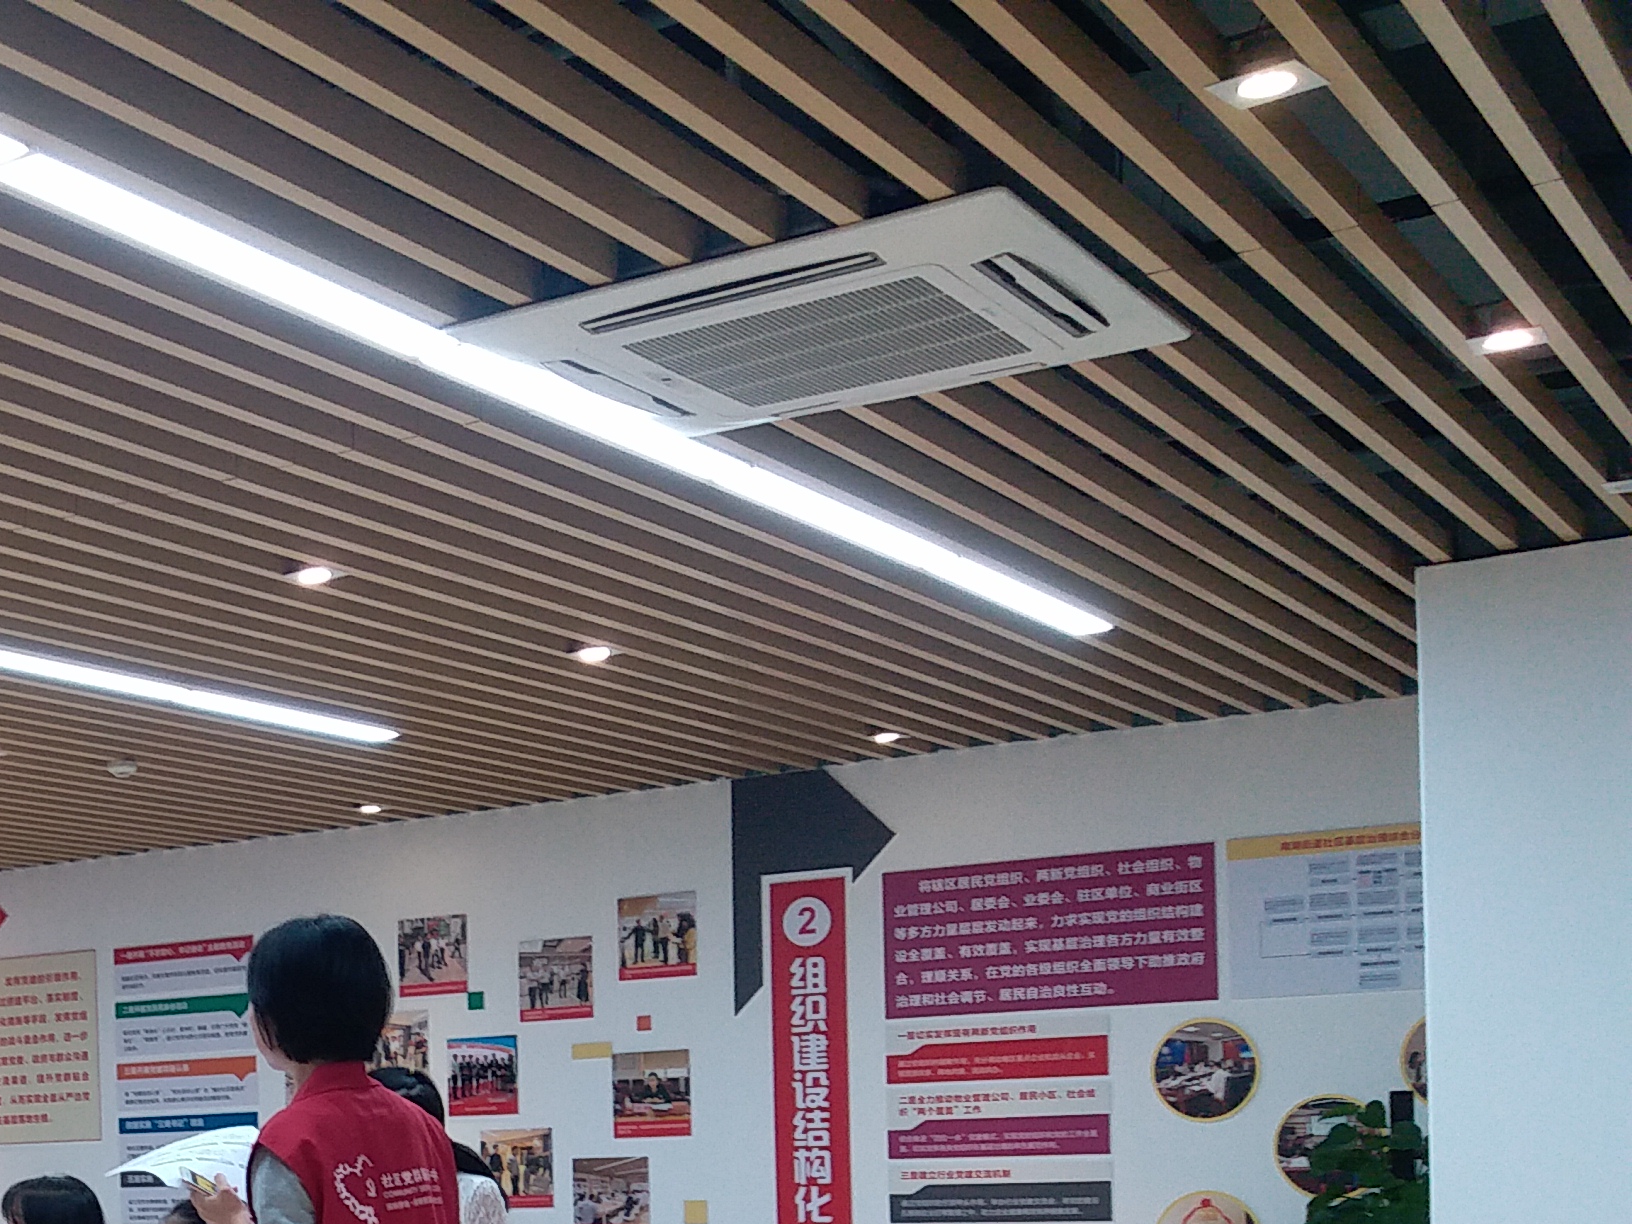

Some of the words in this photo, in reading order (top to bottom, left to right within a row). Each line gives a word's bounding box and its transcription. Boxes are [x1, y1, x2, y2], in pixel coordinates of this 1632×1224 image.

[789, 956, 834, 1224] 组织建设结构化
